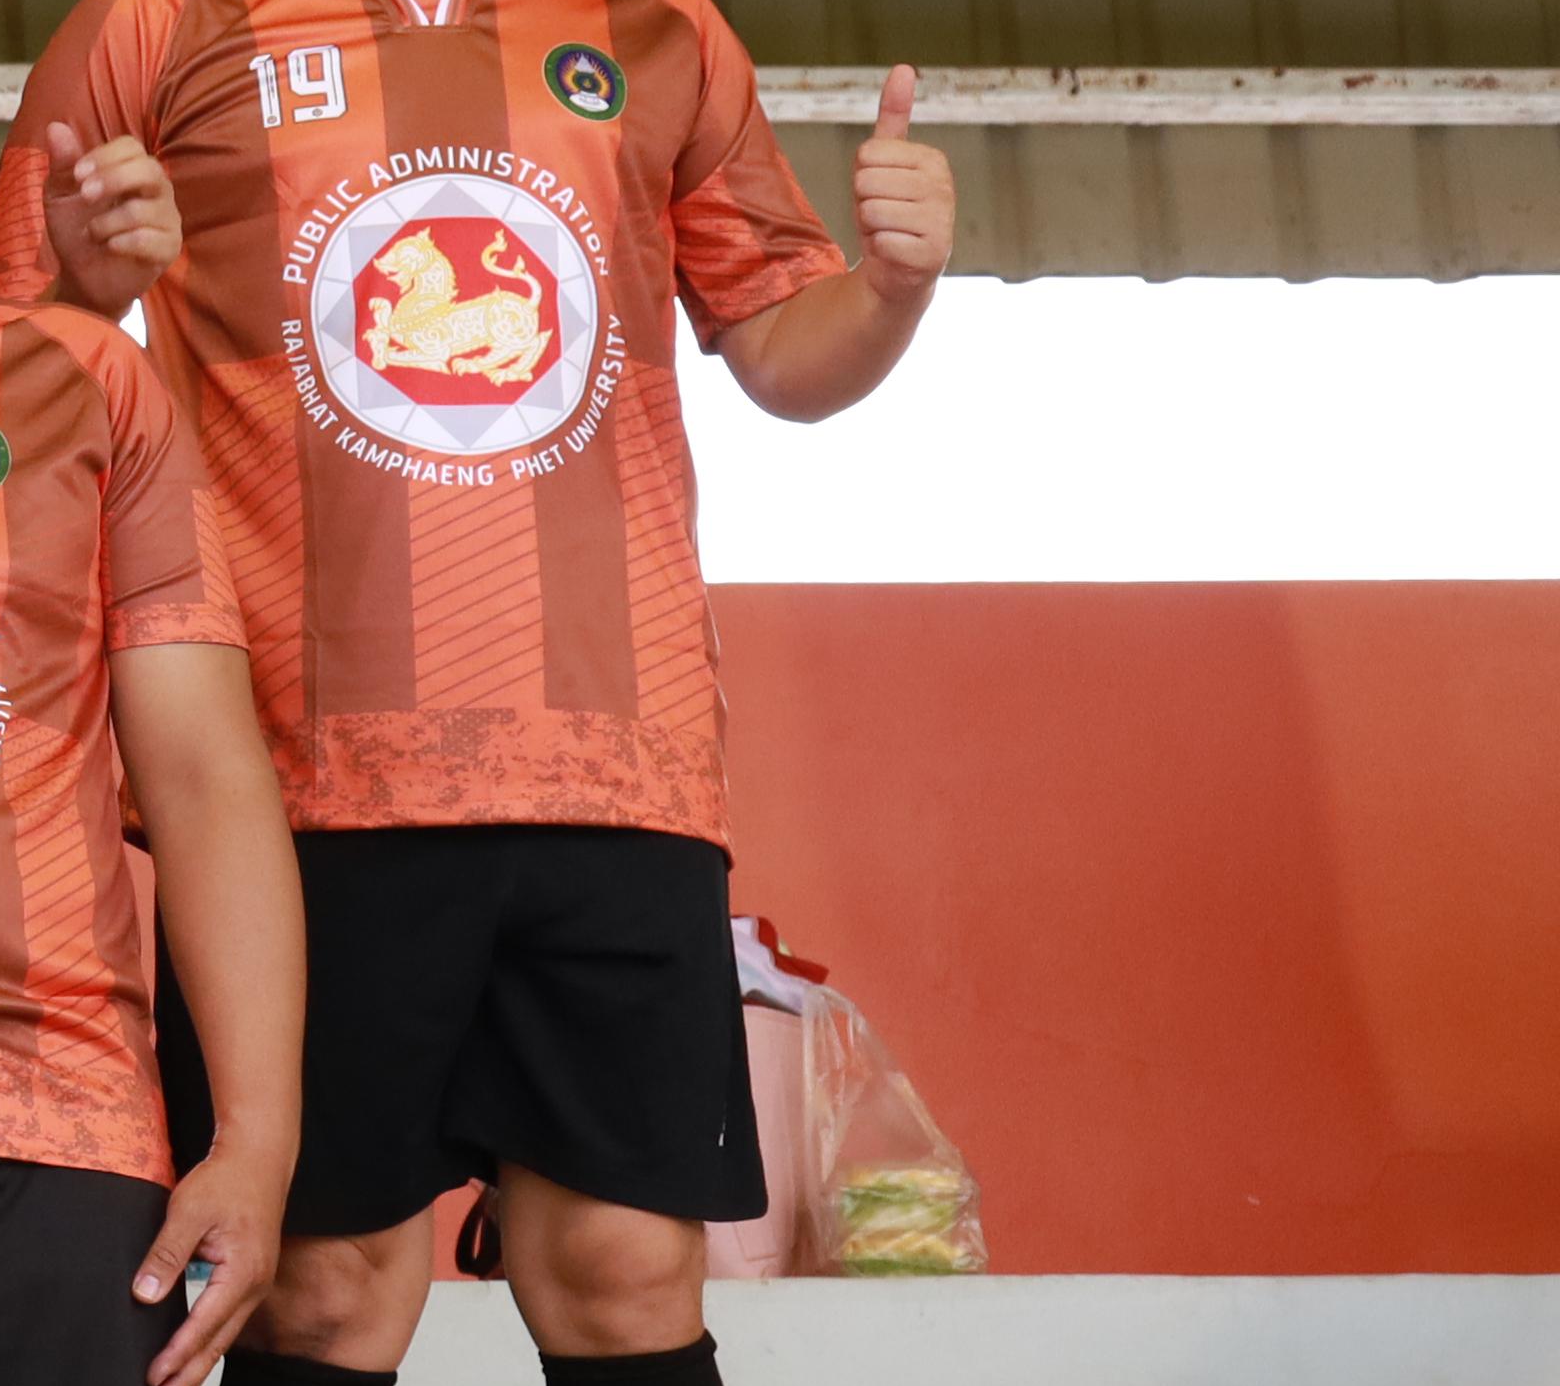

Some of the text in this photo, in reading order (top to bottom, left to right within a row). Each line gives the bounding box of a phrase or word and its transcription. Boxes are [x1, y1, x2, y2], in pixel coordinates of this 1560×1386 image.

[248, 43, 349, 129] 19
[283, 145, 610, 286] PUBLIC ADMINISTRATION
[334, 426, 496, 488] KAMPHAENG
[511, 445, 567, 481] PHET
[565, 313, 627, 456] UNIVERSITY
